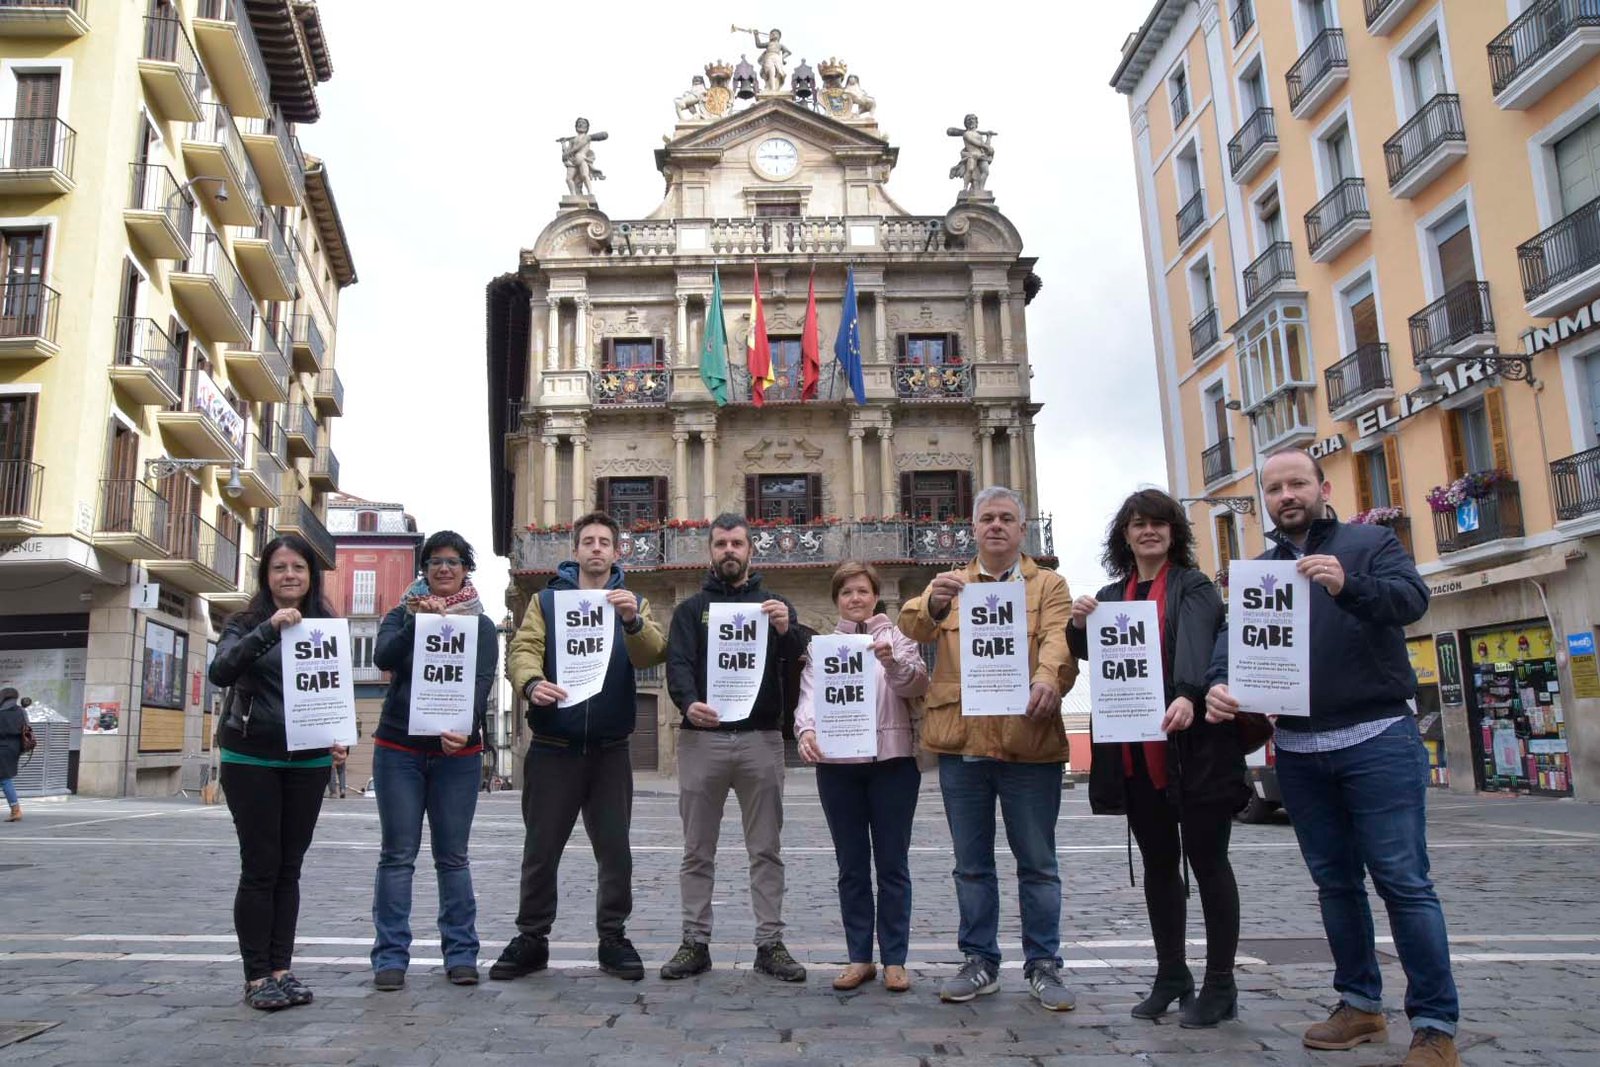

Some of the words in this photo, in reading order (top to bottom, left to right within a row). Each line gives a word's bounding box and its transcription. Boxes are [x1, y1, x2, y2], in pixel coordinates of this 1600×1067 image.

[1304, 434, 1343, 460] CIA
[566, 637, 604, 657] GABE
[972, 637, 1015, 659] GABE
[1242, 625, 1294, 650] GABE
[718, 652, 756, 672] GABE
[1102, 659, 1148, 682] GABE
[296, 671, 340, 693] GABE
[423, 665, 464, 685] GABE
[825, 686, 865, 706] GABE
